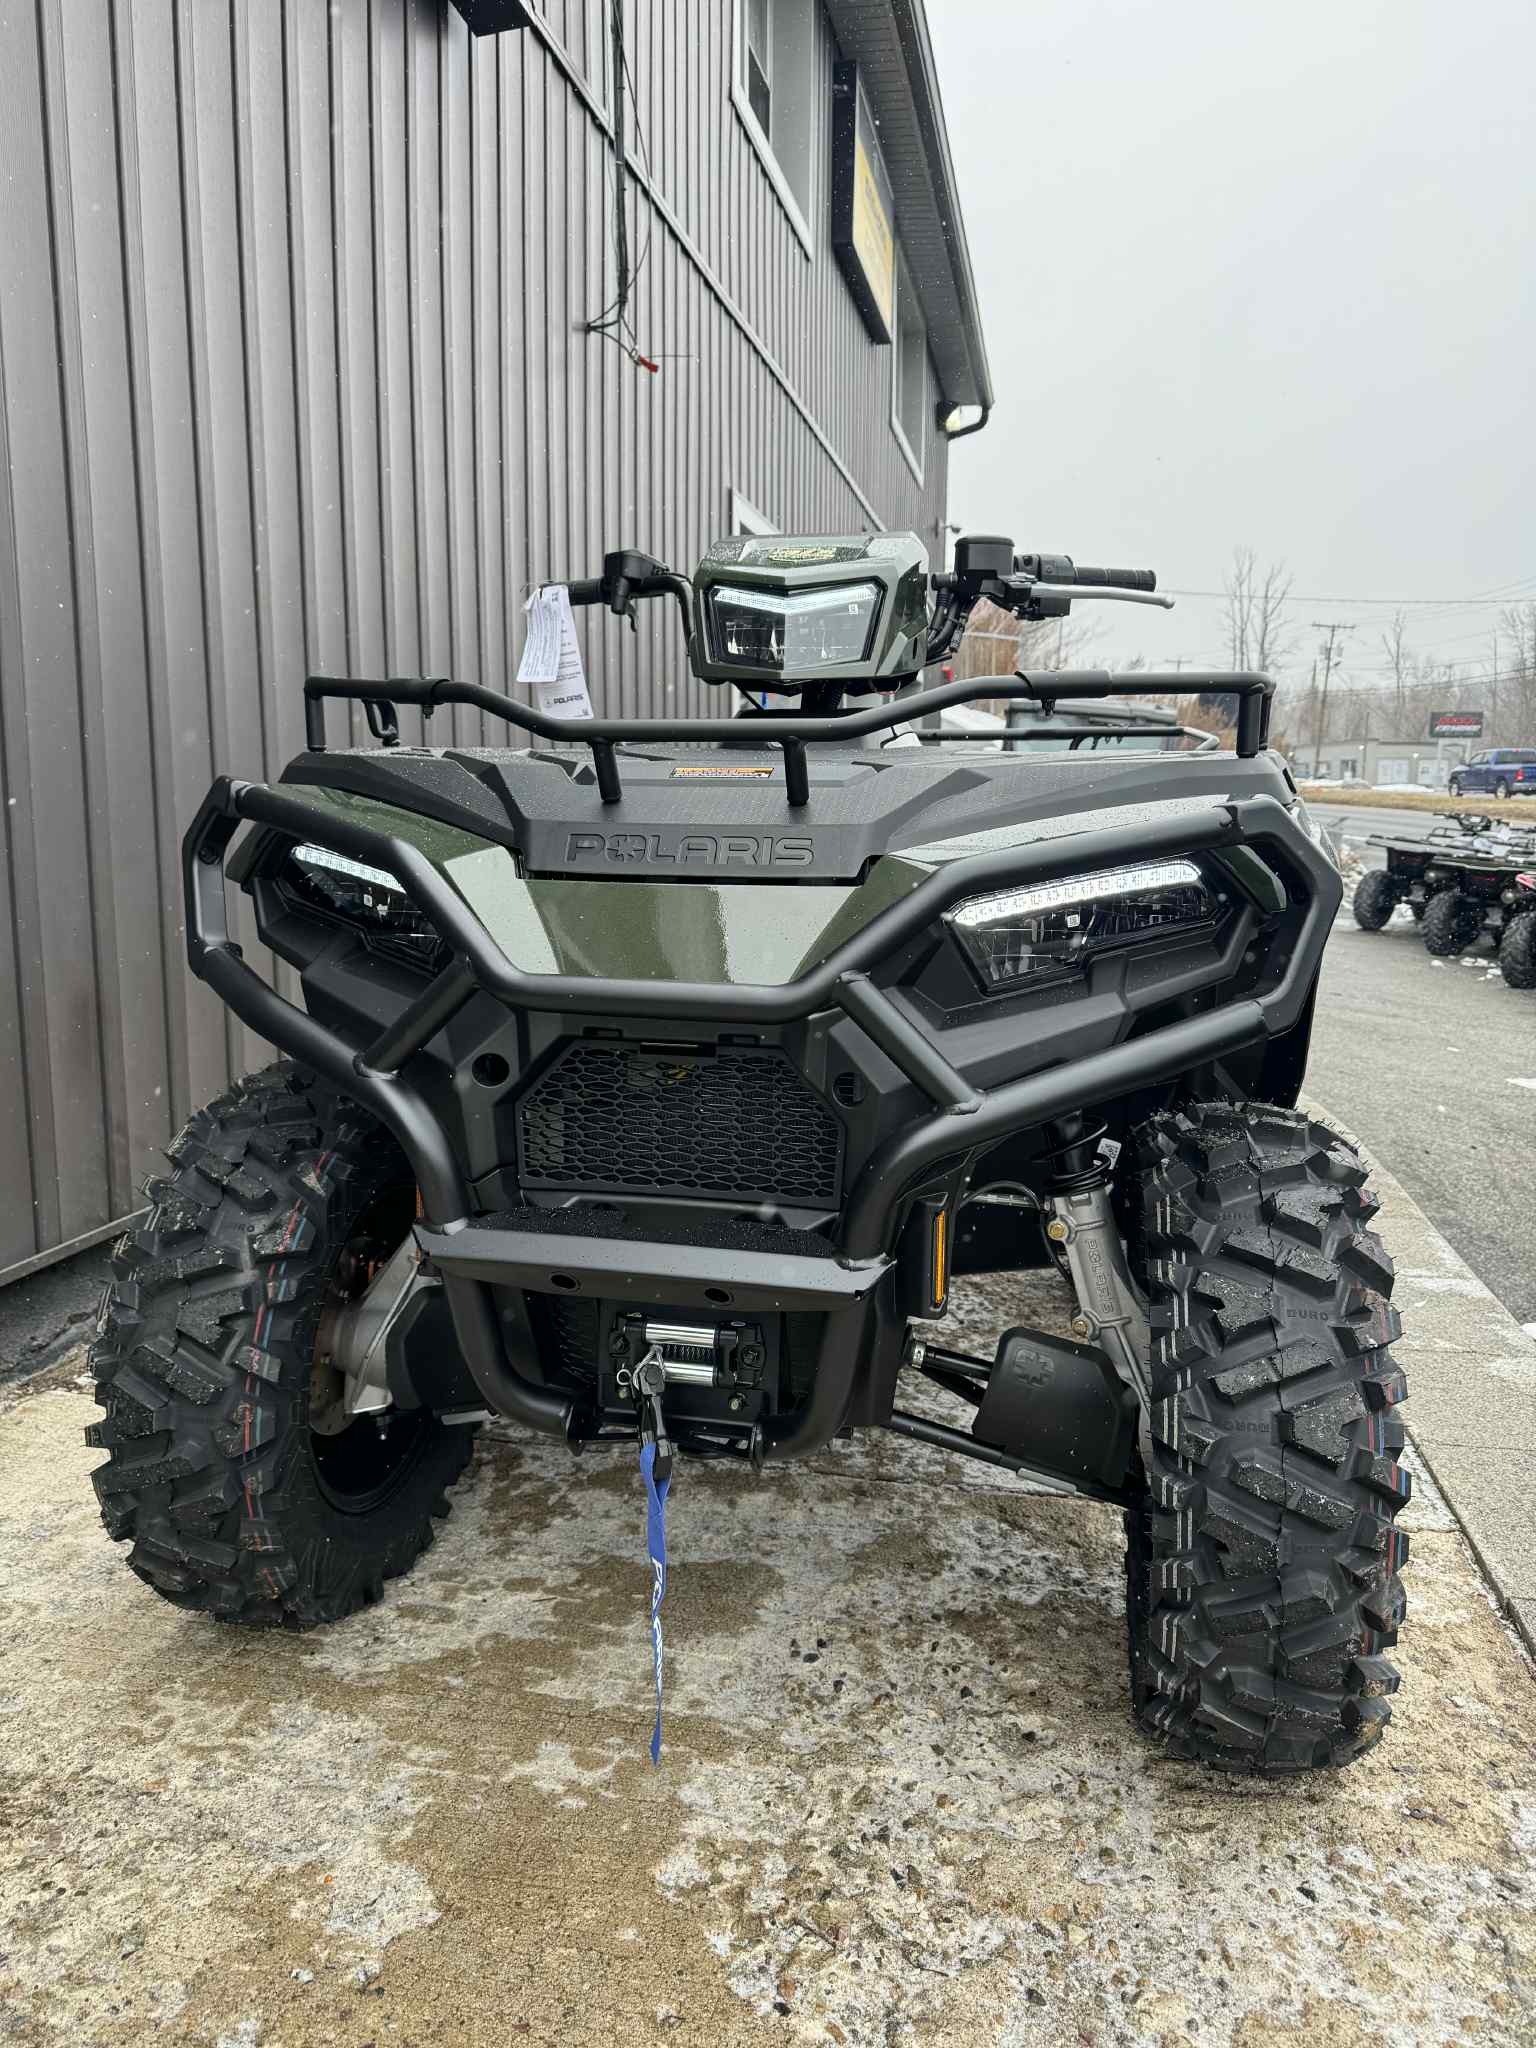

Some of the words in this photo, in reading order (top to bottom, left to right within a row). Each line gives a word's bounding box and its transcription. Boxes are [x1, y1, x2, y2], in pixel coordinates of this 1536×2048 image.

[563, 833, 815, 866] POLARIS
[1087, 1239, 1114, 1313] POLARIS
[1286, 1308, 1329, 1321] DURO
